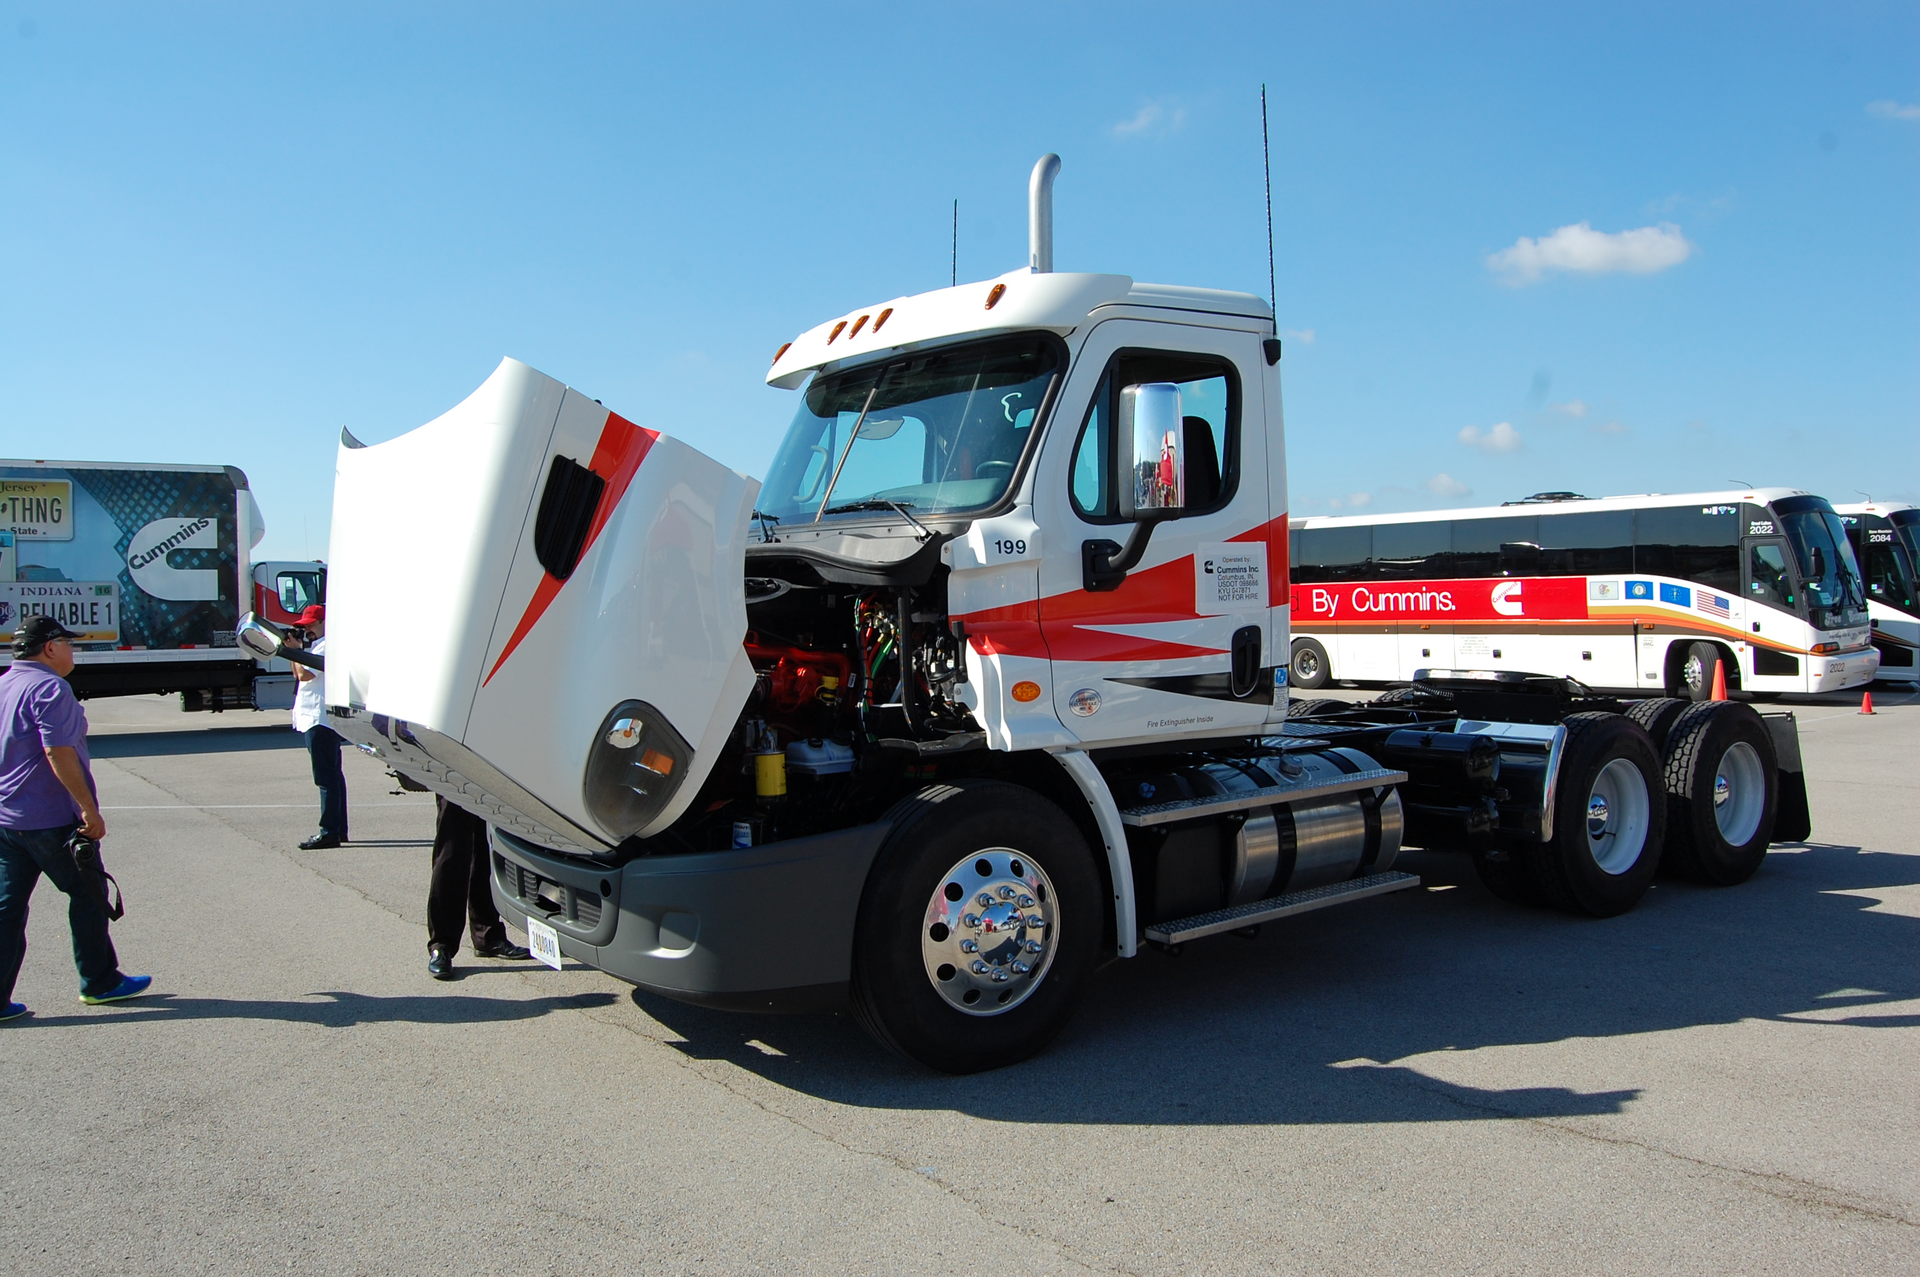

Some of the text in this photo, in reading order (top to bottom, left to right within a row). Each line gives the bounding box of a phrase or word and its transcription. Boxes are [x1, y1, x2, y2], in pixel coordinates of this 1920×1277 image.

[0, 482, 38, 493] Jersey
[8, 496, 62, 524] THNG
[10, 526, 38, 535] State
[1749, 525, 1773, 535] 2022
[129, 517, 210, 570] Cummins
[1869, 534, 1892, 542] 2084
[995, 539, 1026, 555] 199
[1216, 565, 1259, 574] Cummins Inc.
[20, 587, 82, 596] INDIANA
[1492, 580, 1519, 604] Cummins
[1312, 588, 1340, 618] By
[1352, 586, 1456, 612] Cummins.
[105, 602, 112, 625] 1
[1829, 662, 1845, 673] 2022
[1147, 715, 1214, 728] Fire Extinguisher Inside
